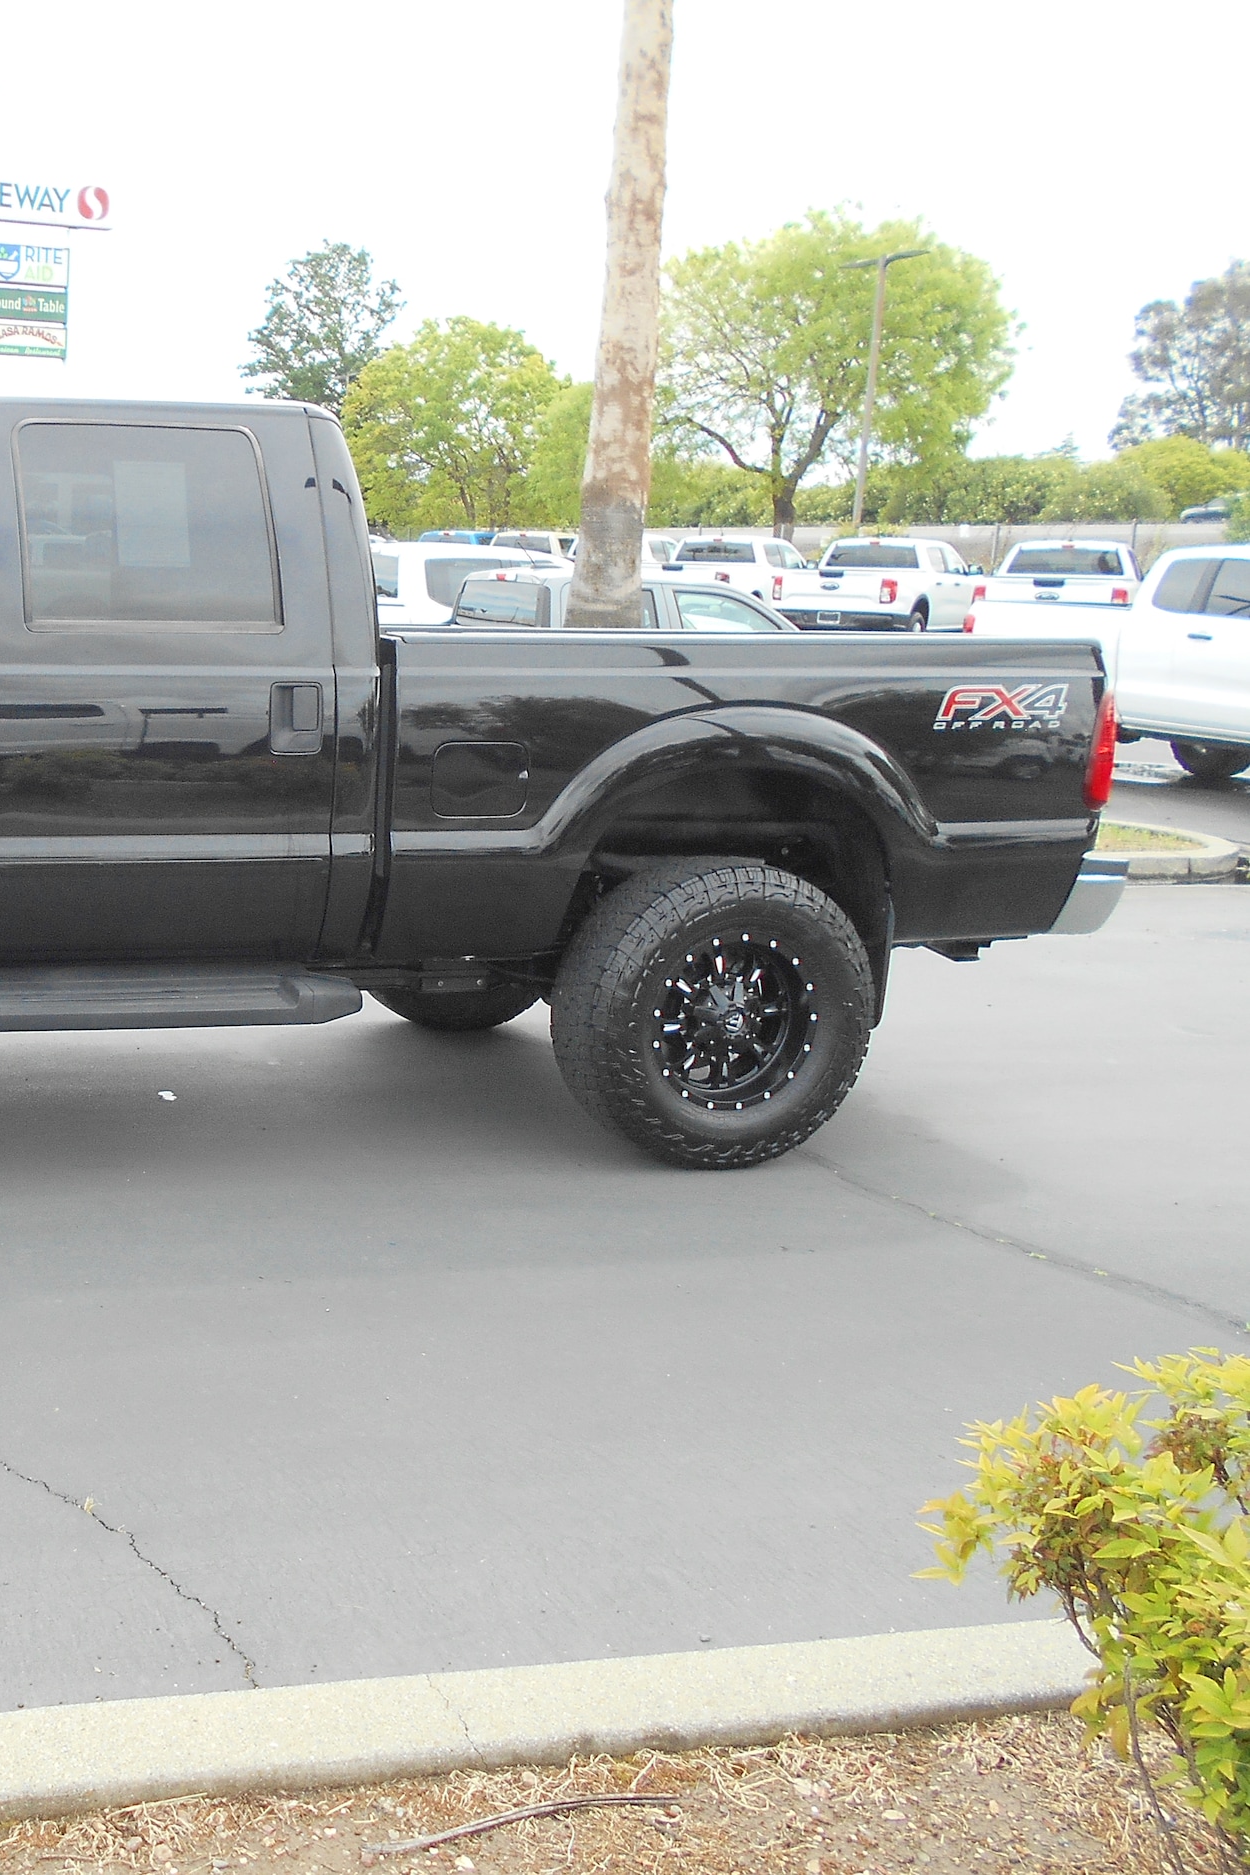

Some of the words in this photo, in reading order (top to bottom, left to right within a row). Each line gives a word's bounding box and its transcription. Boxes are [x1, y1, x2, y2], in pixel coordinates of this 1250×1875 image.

[25, 245, 63, 265] RITE
[24, 265, 54, 282] AID
[37, 298, 65, 314] Table
[21, 326, 58, 345] RAMOS
[935, 684, 1069, 720] FX4
[933, 721, 983, 730] OFF
[992, 720, 1061, 729] ROAD
